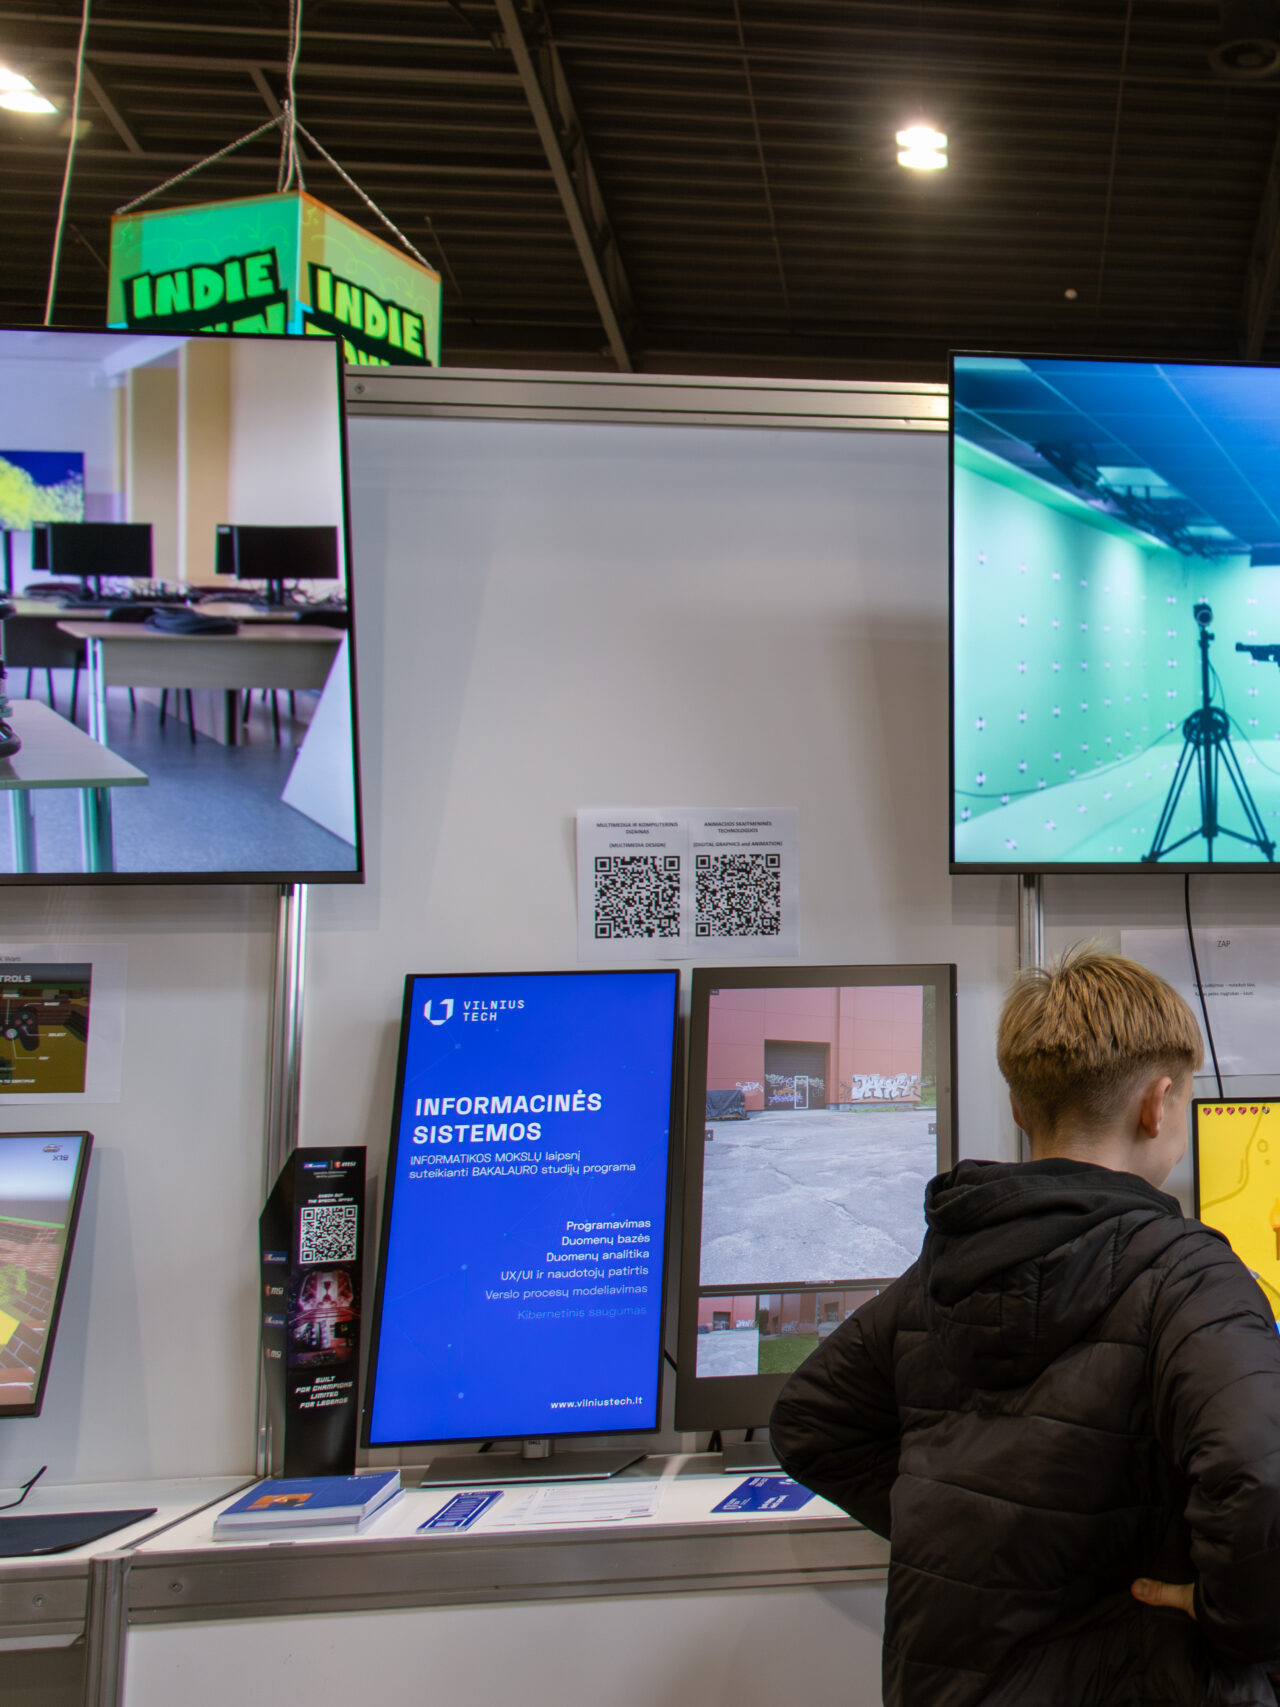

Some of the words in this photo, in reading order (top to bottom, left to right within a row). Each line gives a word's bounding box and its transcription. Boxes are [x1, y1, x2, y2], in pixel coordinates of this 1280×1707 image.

[133, 252, 276, 319] INDIE
[315, 268, 424, 359] INDIE
[0, 975, 32, 983] TROLS
[463, 1000, 525, 1010] VILNIUS
[463, 1012, 498, 1022] TECH
[415, 1089, 602, 1116] INFORMACINĖS
[412, 1122, 542, 1144] SISTEMOS
[410, 1152, 492, 1165] INFORMATIKOS
[495, 1151, 542, 1164] MOKSLŲ
[545, 1150, 581, 1163] laipsnį
[409, 1166, 469, 1179] suteikianti
[472, 1165, 538, 1177] BAKALAURO
[541, 1163, 580, 1176] studijų
[583, 1163, 636, 1175] programa
[566, 1219, 651, 1232] Programavimas
[562, 1235, 614, 1247] Duomenų
[617, 1233, 650, 1244] bazės
[546, 1251, 599, 1263] Duomenų
[602, 1249, 650, 1261] analitika
[500, 1270, 533, 1282] UX/UI
[536, 1269, 545, 1280] ir
[547, 1267, 605, 1280] naudotojų
[608, 1266, 649, 1279] patirtis
[485, 1289, 520, 1300] Verslo
[523, 1287, 569, 1300] procesų
[572, 1284, 648, 1297] modeliavimas
[517, 1307, 585, 1320] Kibernetinis
[589, 1305, 647, 1319] saugumas
[314, 1376, 336, 1384] BUILT
[294, 1386, 311, 1394] FOR
[312, 1381, 353, 1392] CHAMPIONS
[310, 1391, 339, 1400] LIMITED
[550, 1396, 643, 1409] www.vilniustech.lt
[299, 1401, 315, 1409] FOR
[317, 1397, 348, 1407] LEGENDS
